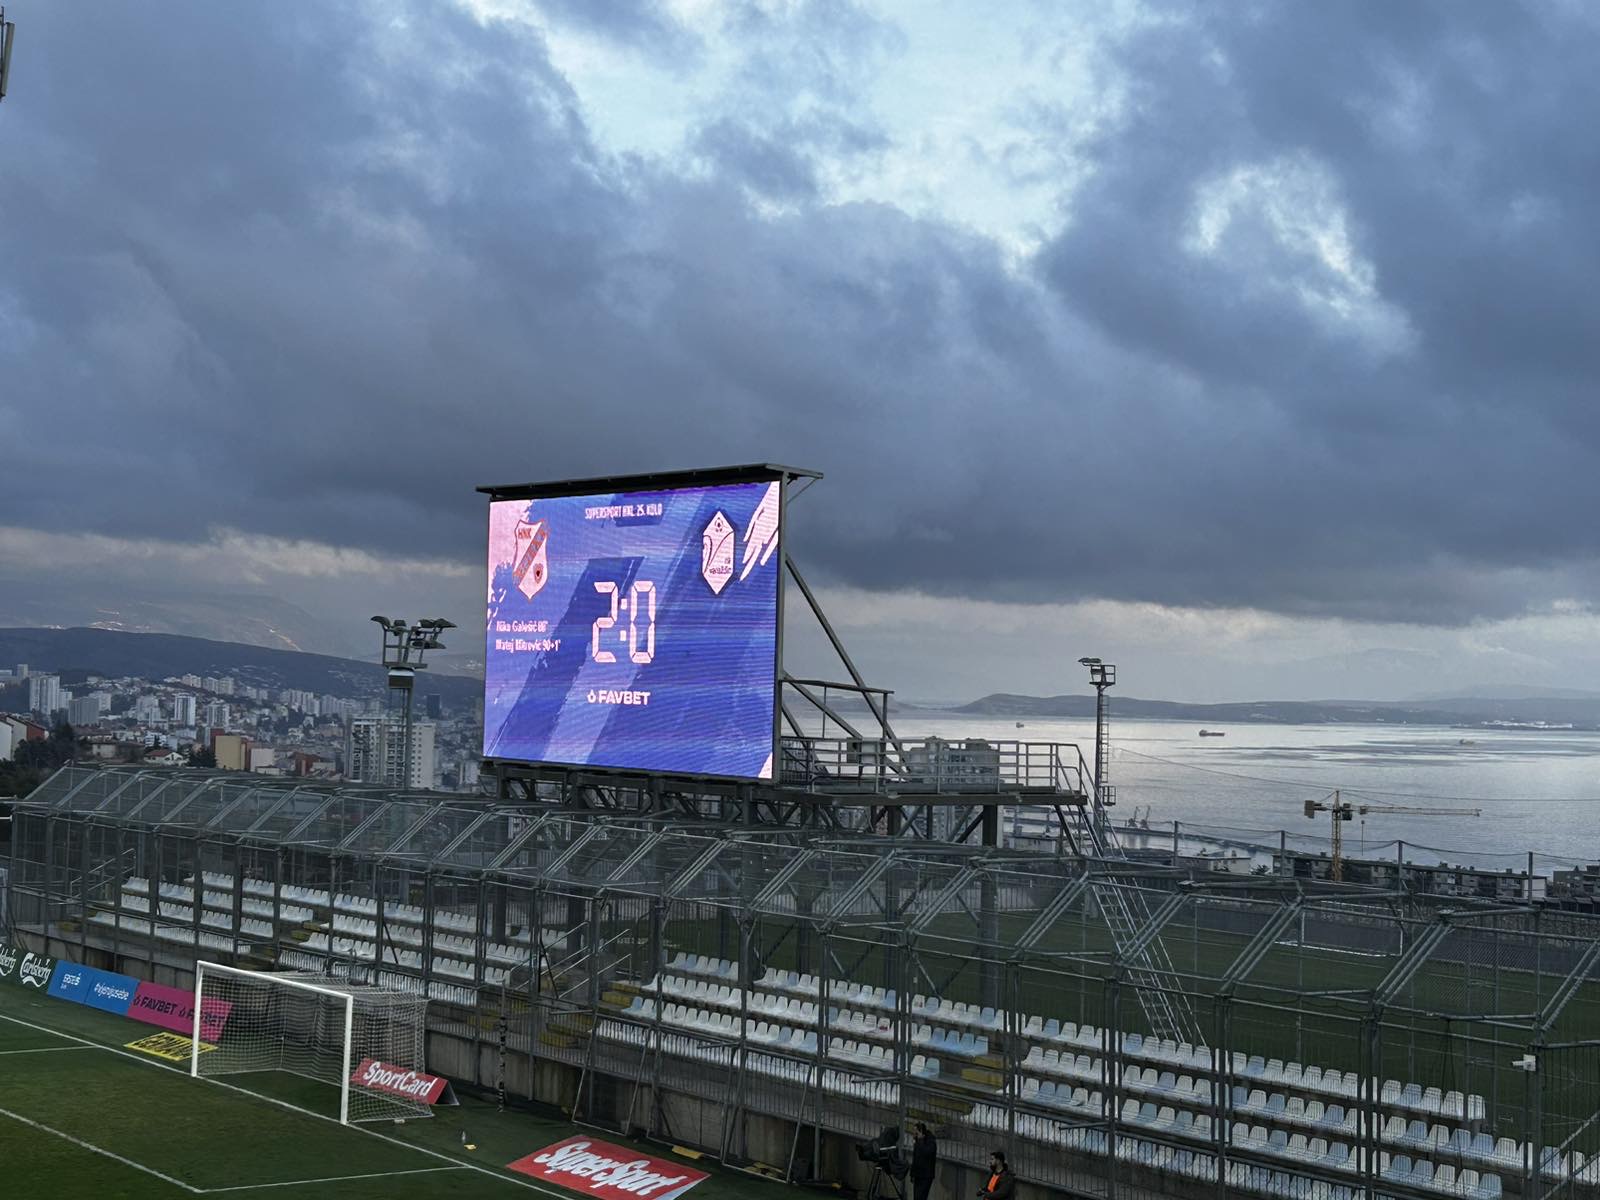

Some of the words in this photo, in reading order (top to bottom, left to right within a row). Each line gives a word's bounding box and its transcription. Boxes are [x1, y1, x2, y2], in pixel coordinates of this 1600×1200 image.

[592, 581, 656, 663] 2:0
[599, 690, 650, 706] FAVBET
[20, 952, 52, 985] Carlsberg
[140, 996, 178, 1016] FAVBET
[362, 1061, 439, 1097] SportCard
[533, 1141, 688, 1196] SuperSport
